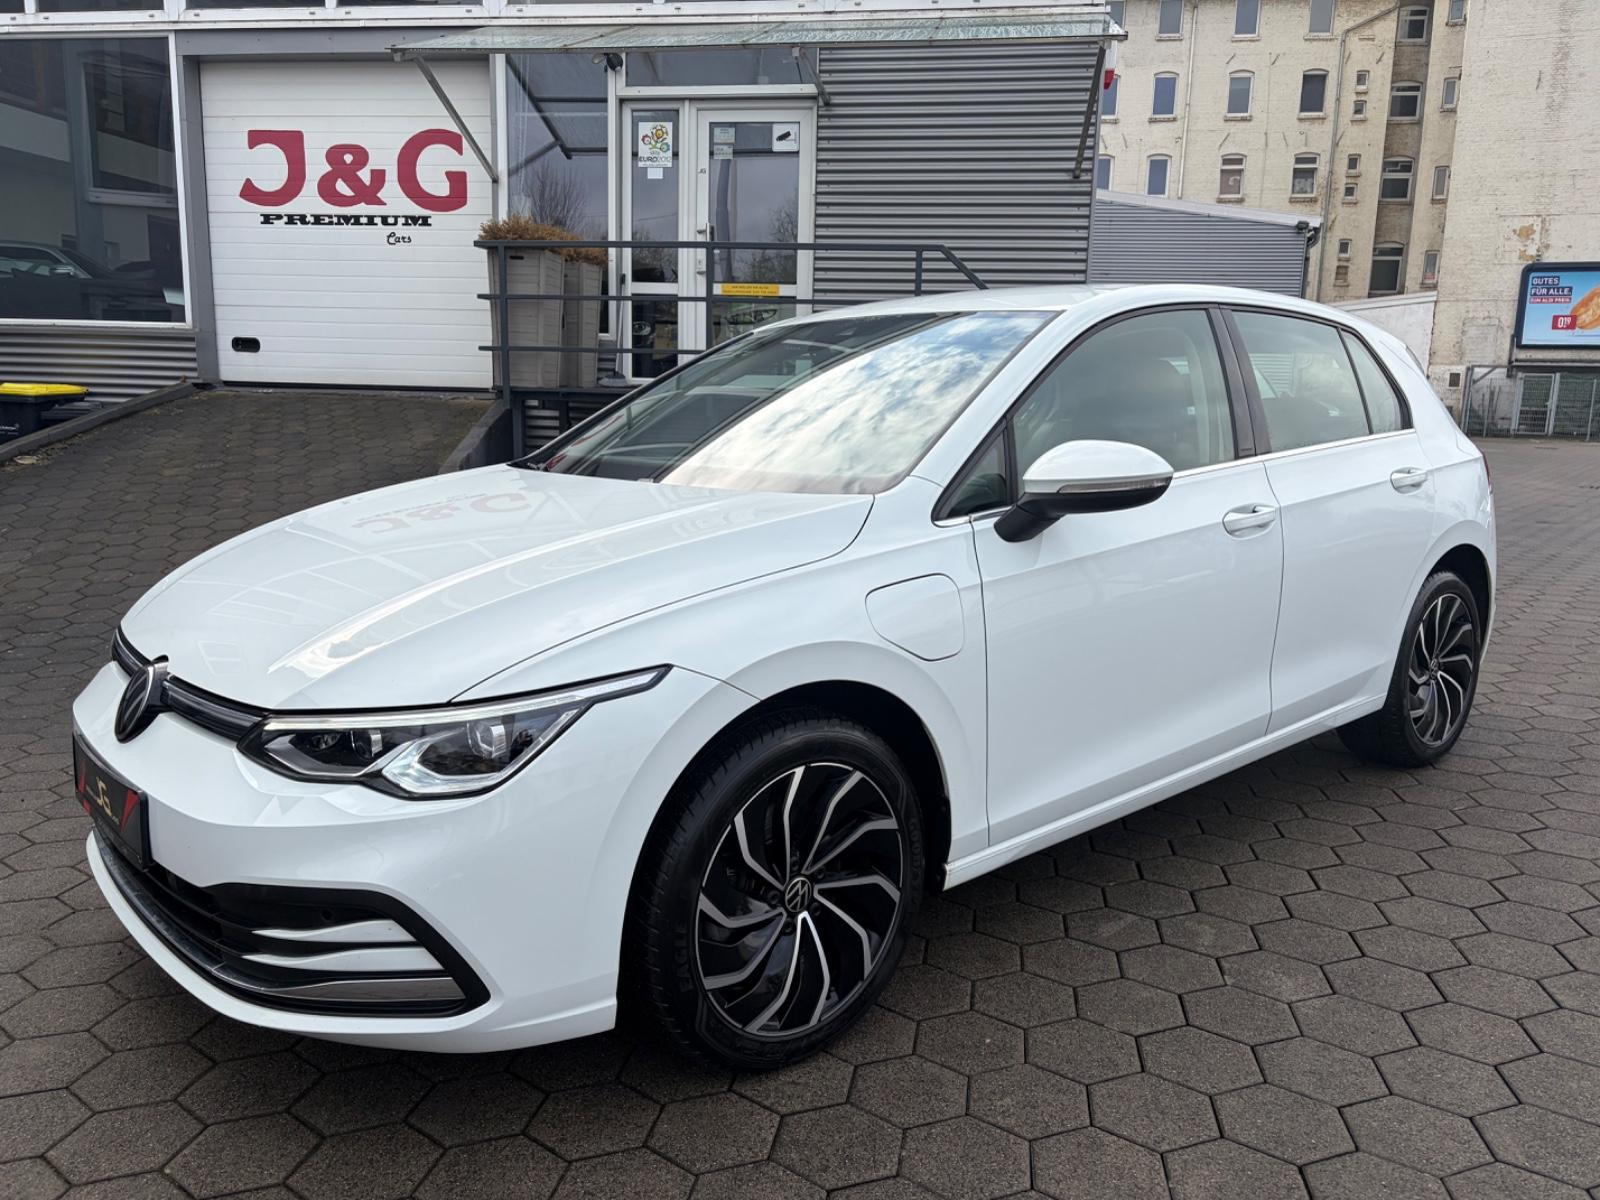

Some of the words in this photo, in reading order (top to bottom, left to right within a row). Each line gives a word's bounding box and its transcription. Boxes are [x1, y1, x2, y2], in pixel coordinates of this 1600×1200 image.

[239, 128, 468, 212] J&G
[260, 213, 432, 227] PREMIUM
[386, 231, 412, 246] Cars
[1532, 277, 1559, 285] GUTES
[1531, 286, 1548, 296] FÜR
